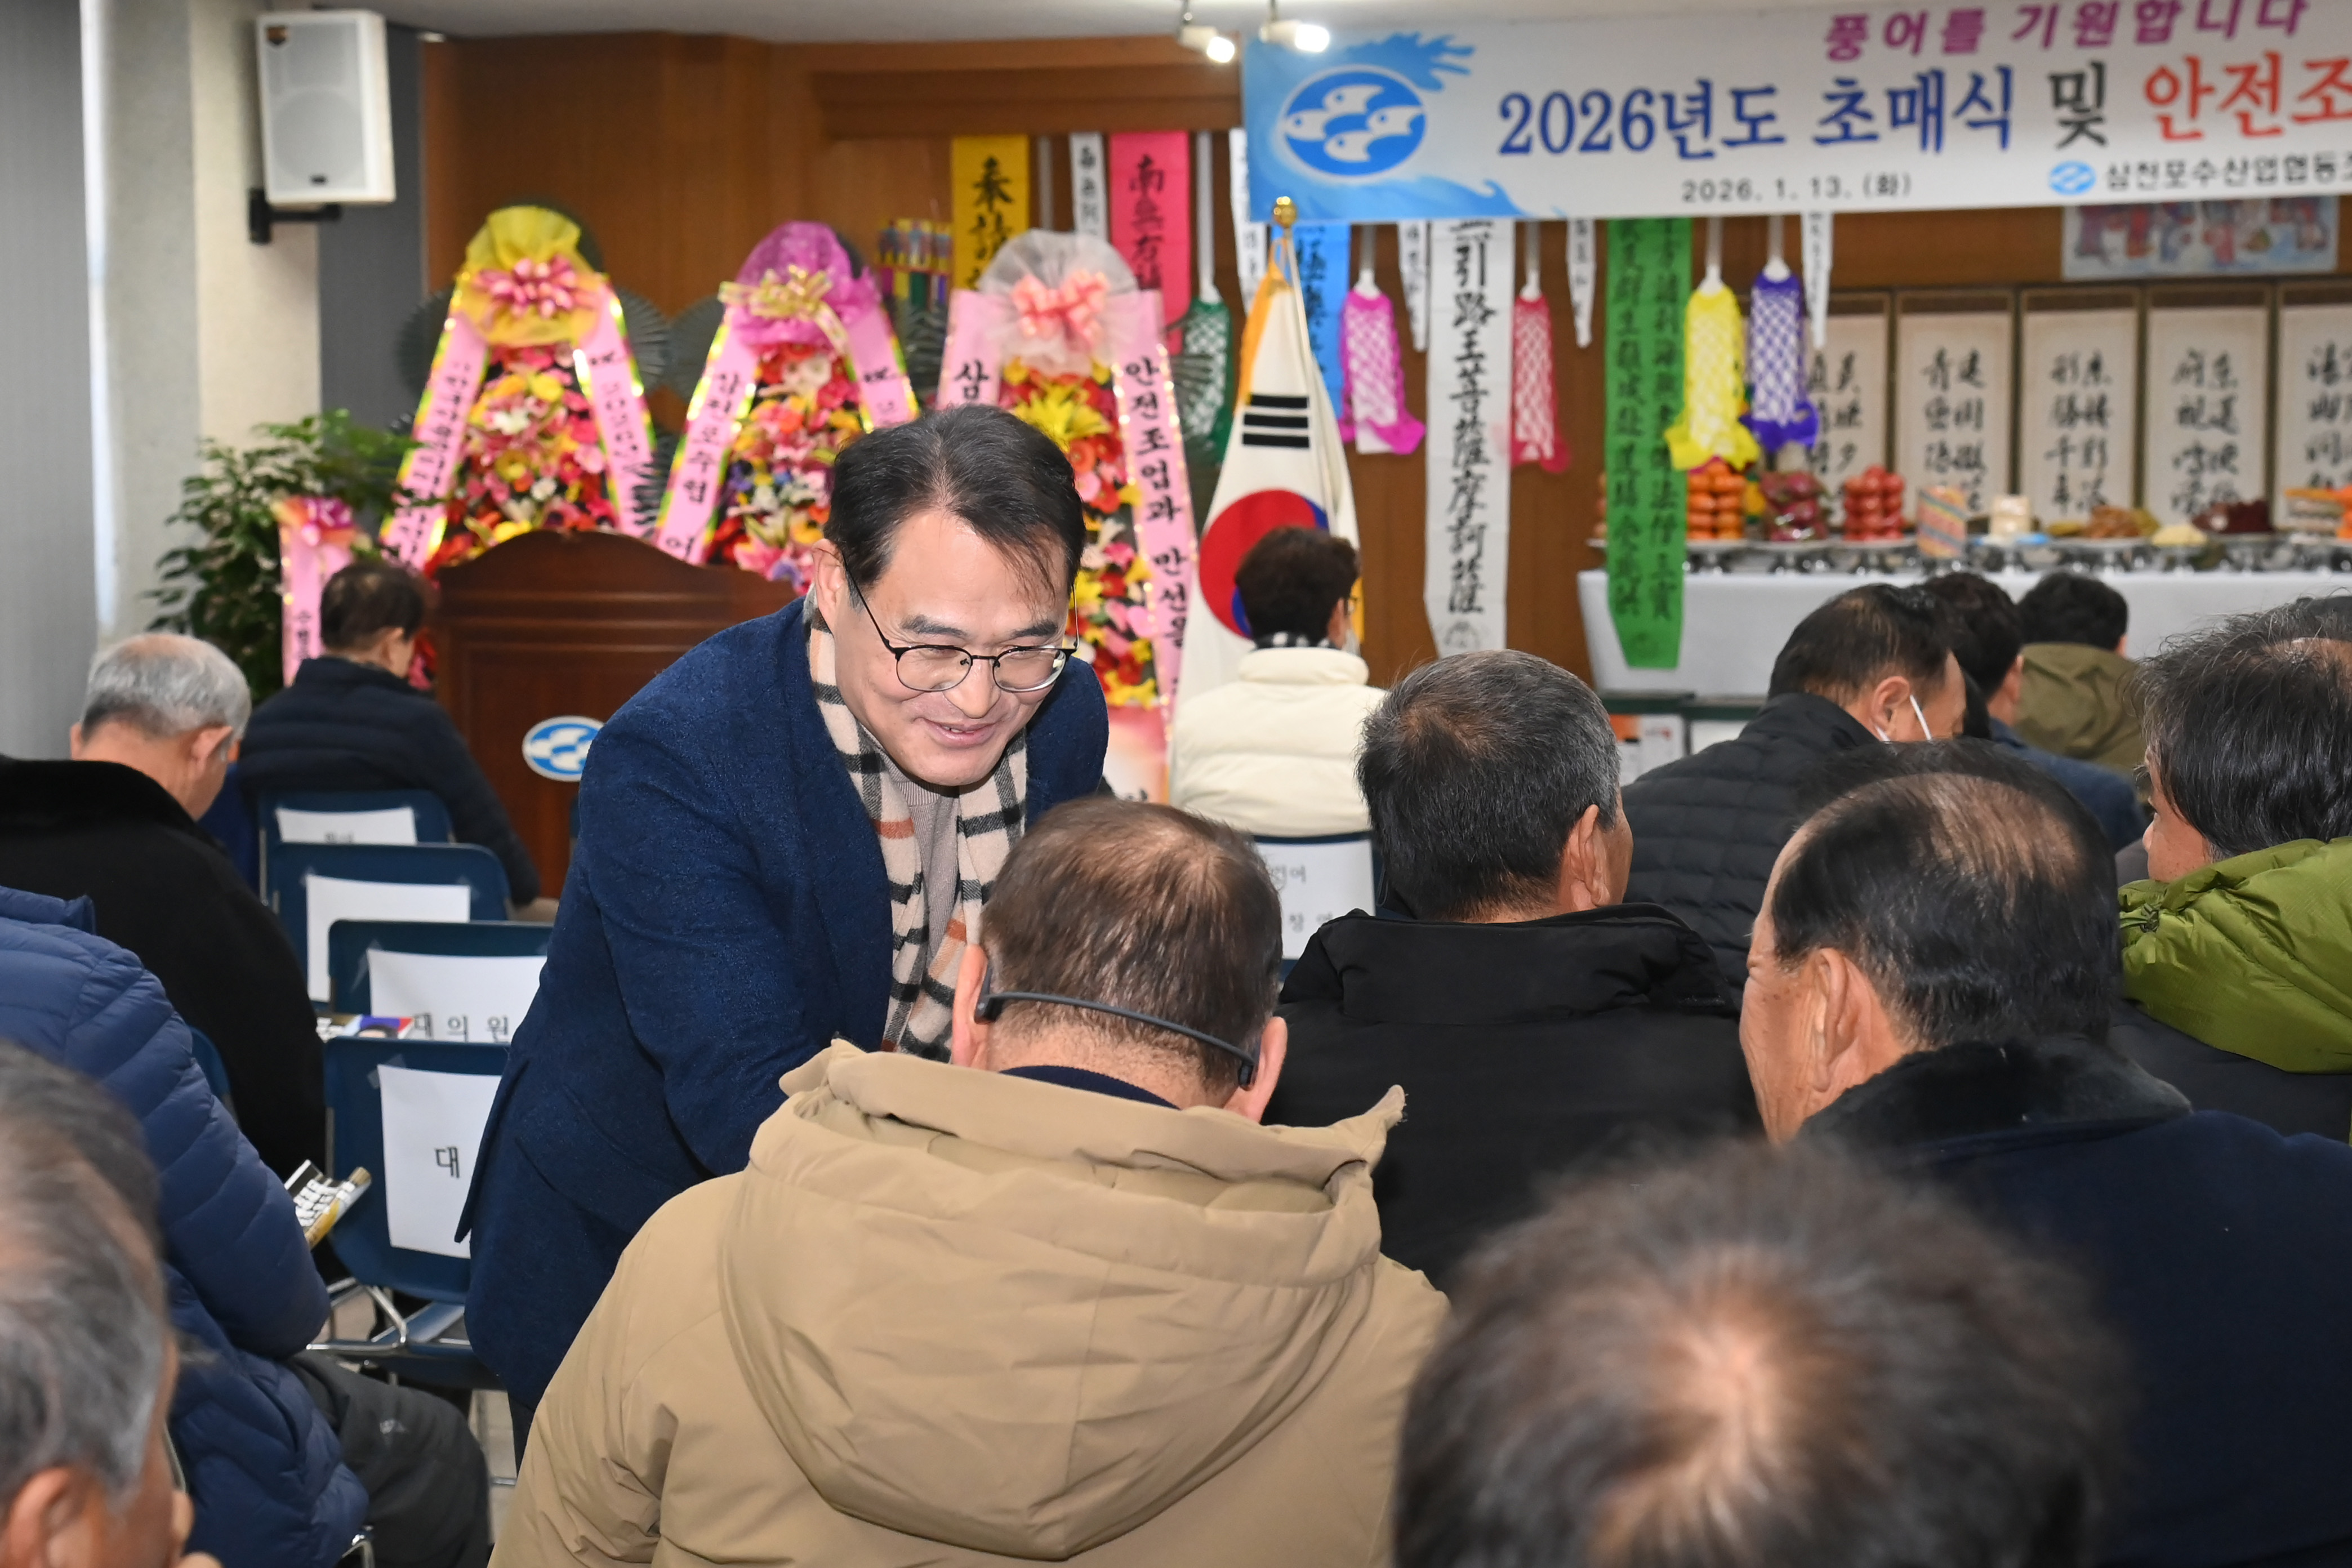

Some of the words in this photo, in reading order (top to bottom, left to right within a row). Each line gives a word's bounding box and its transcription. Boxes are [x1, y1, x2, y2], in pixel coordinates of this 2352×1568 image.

[1825, 10, 1985, 61] 풍어를
[2012, 0, 2308, 47] 기원합니다
[1499, 78, 1785, 160] 2026년도
[1812, 64, 2012, 152] 초매식
[2047, 60, 2107, 149] 및
[2144, 50, 2352, 142] 안전조
[1682, 177, 1763, 203] 2026.
[1774, 176, 1799, 201] 1.
[1810, 174, 1852, 201] 13.
[1863, 171, 1912, 199] (화)
[954, 359, 990, 400] 삼
[1125, 356, 1181, 524] 안전조업과
[435, 1146, 460, 1179] 대
